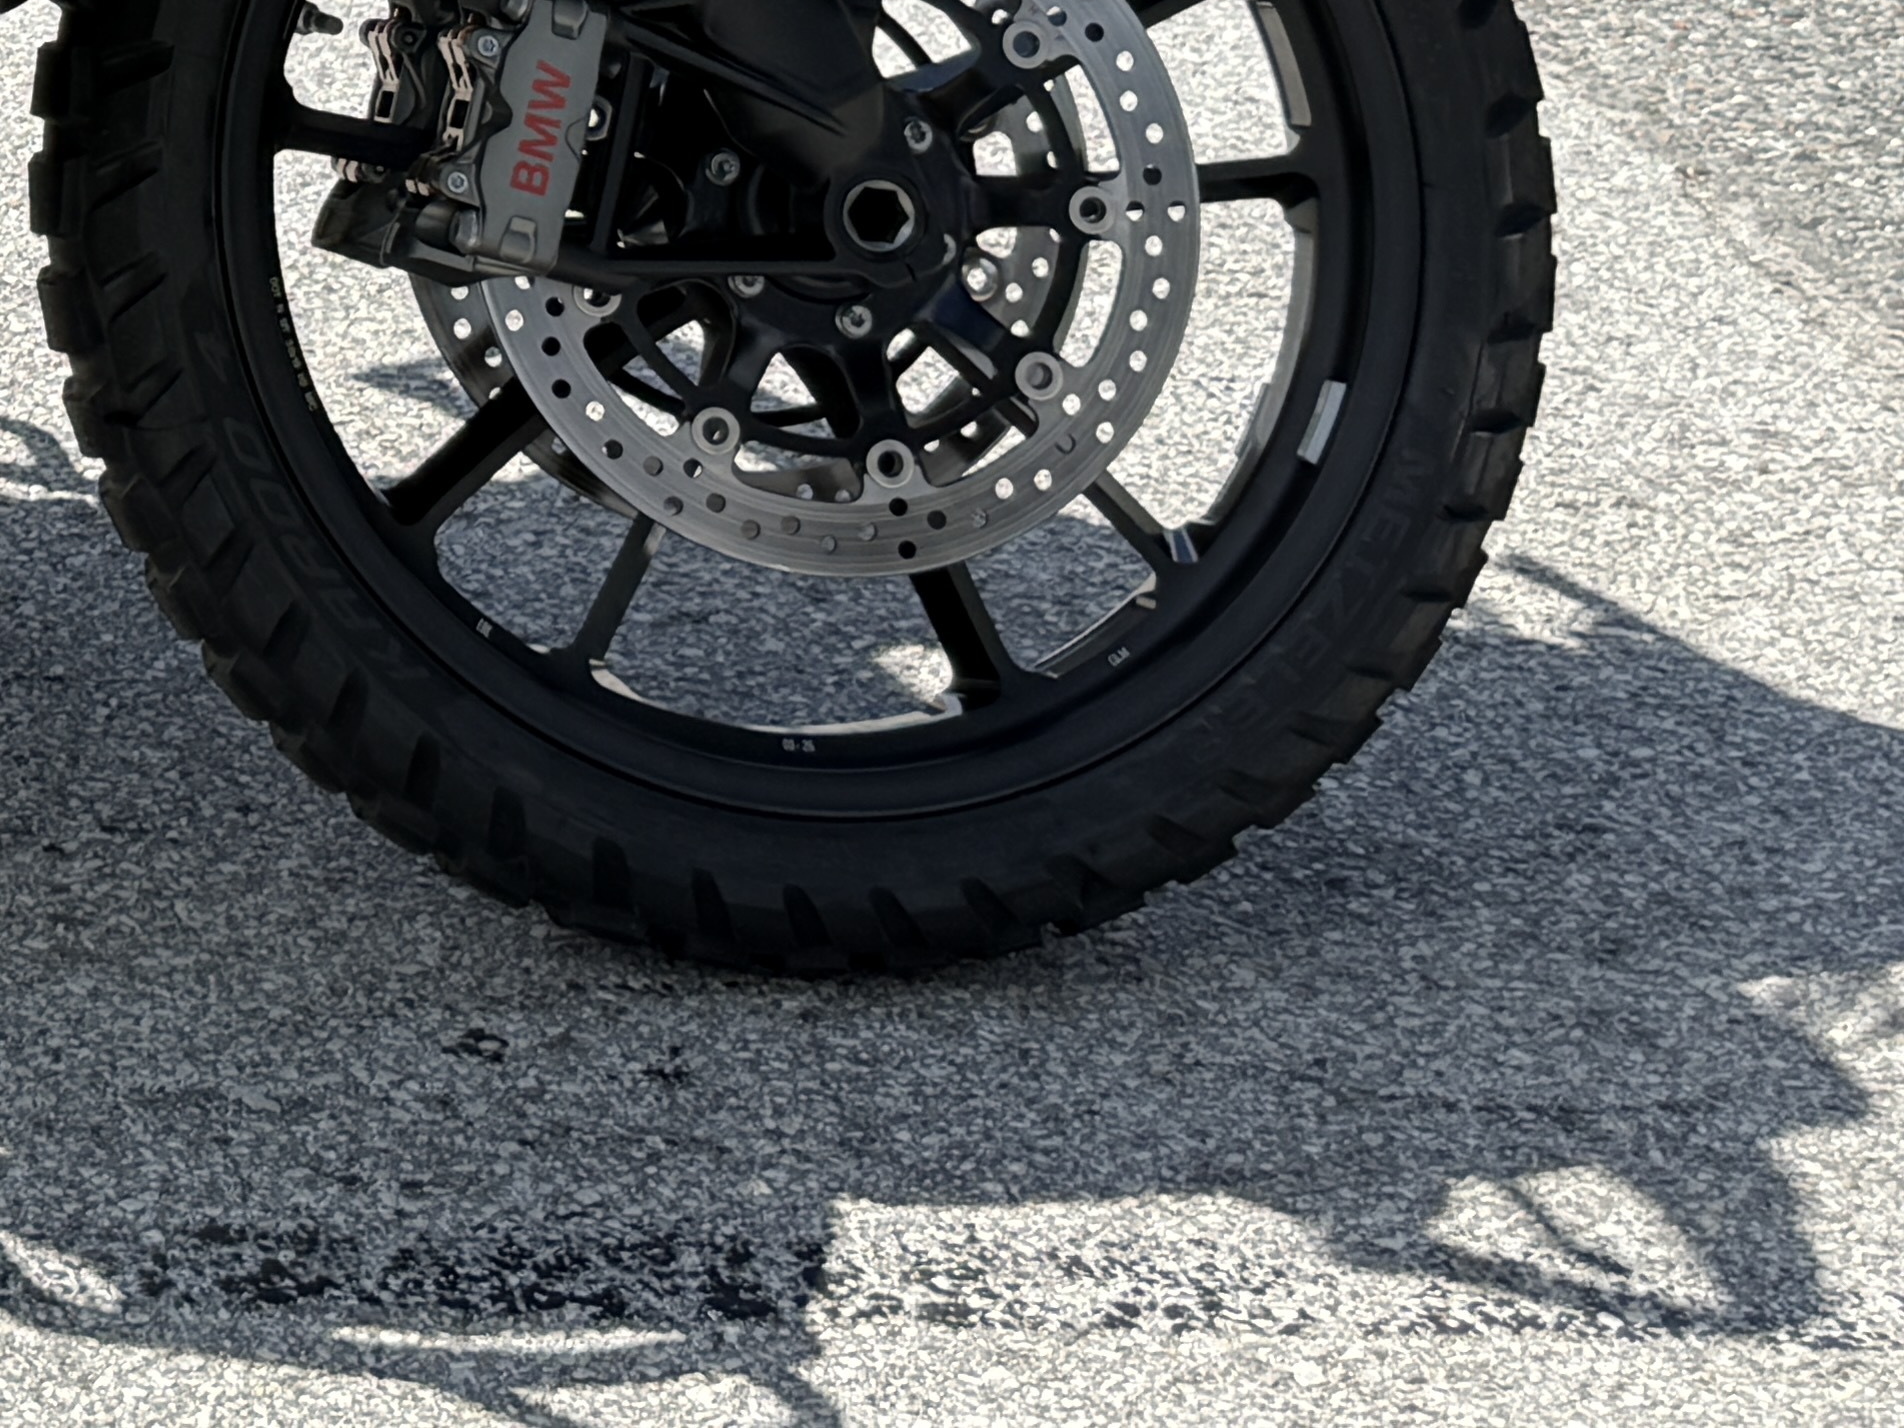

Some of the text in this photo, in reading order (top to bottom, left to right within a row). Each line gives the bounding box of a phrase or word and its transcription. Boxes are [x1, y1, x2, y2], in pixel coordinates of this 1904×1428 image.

[509, 59, 573, 196] BMW
[220, 414, 432, 680] KAROO
[1192, 444, 1438, 762] METZELER
